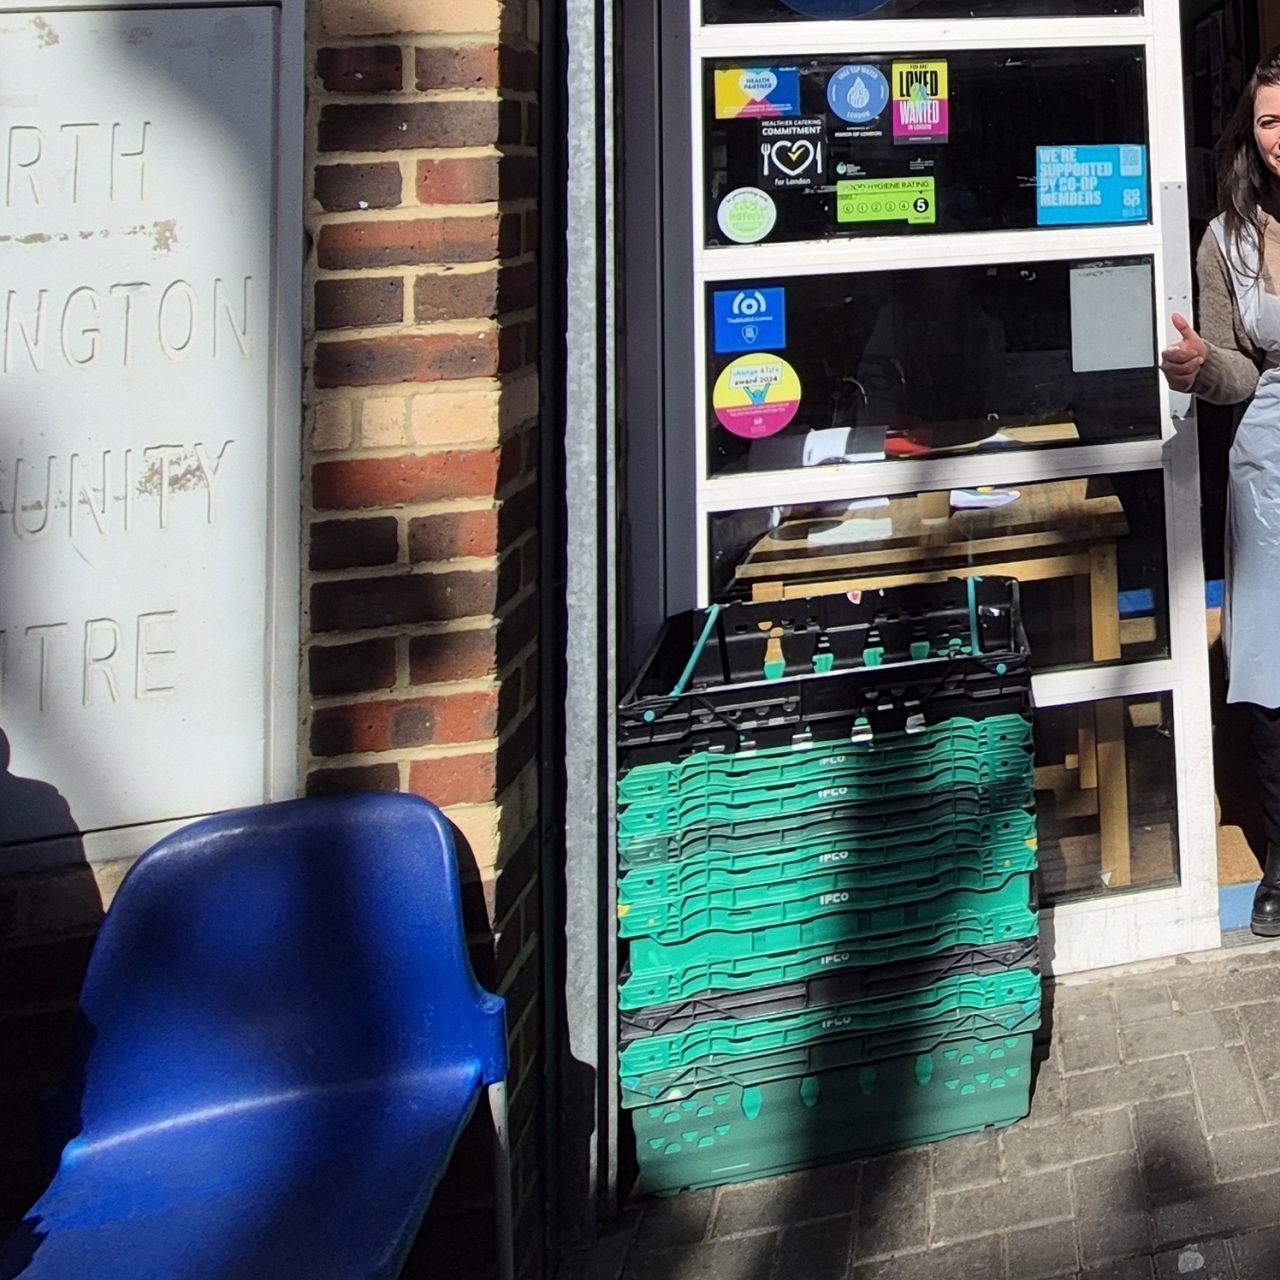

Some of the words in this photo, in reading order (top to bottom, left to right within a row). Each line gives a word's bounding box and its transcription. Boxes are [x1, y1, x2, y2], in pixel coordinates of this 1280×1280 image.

[900, 100, 940, 125] WANTED
[762, 126, 822, 136] COMMITMENT
[1040, 148, 1077, 163] WE'RE
[1040, 161, 1113, 177] SUPPORTED
[775, 178, 785, 186] for
[786, 178, 811, 186] London
[867, 182, 900, 190] HYGIENE
[1040, 177, 1057, 192] BY
[1058, 176, 1098, 191] CO-OP
[1040, 190, 1102, 207] MEMBERS
[3, 276, 252, 374] NGTON
[735, 376, 758, 385] award
[0, 609, 178, 713] TRE
[818, 787, 848, 799] IFCO
[819, 851, 849, 862] IFCO
[820, 892, 849, 905] IFCO
[821, 952, 850, 964] IFCO
[822, 1016, 851, 1029] IFCO
